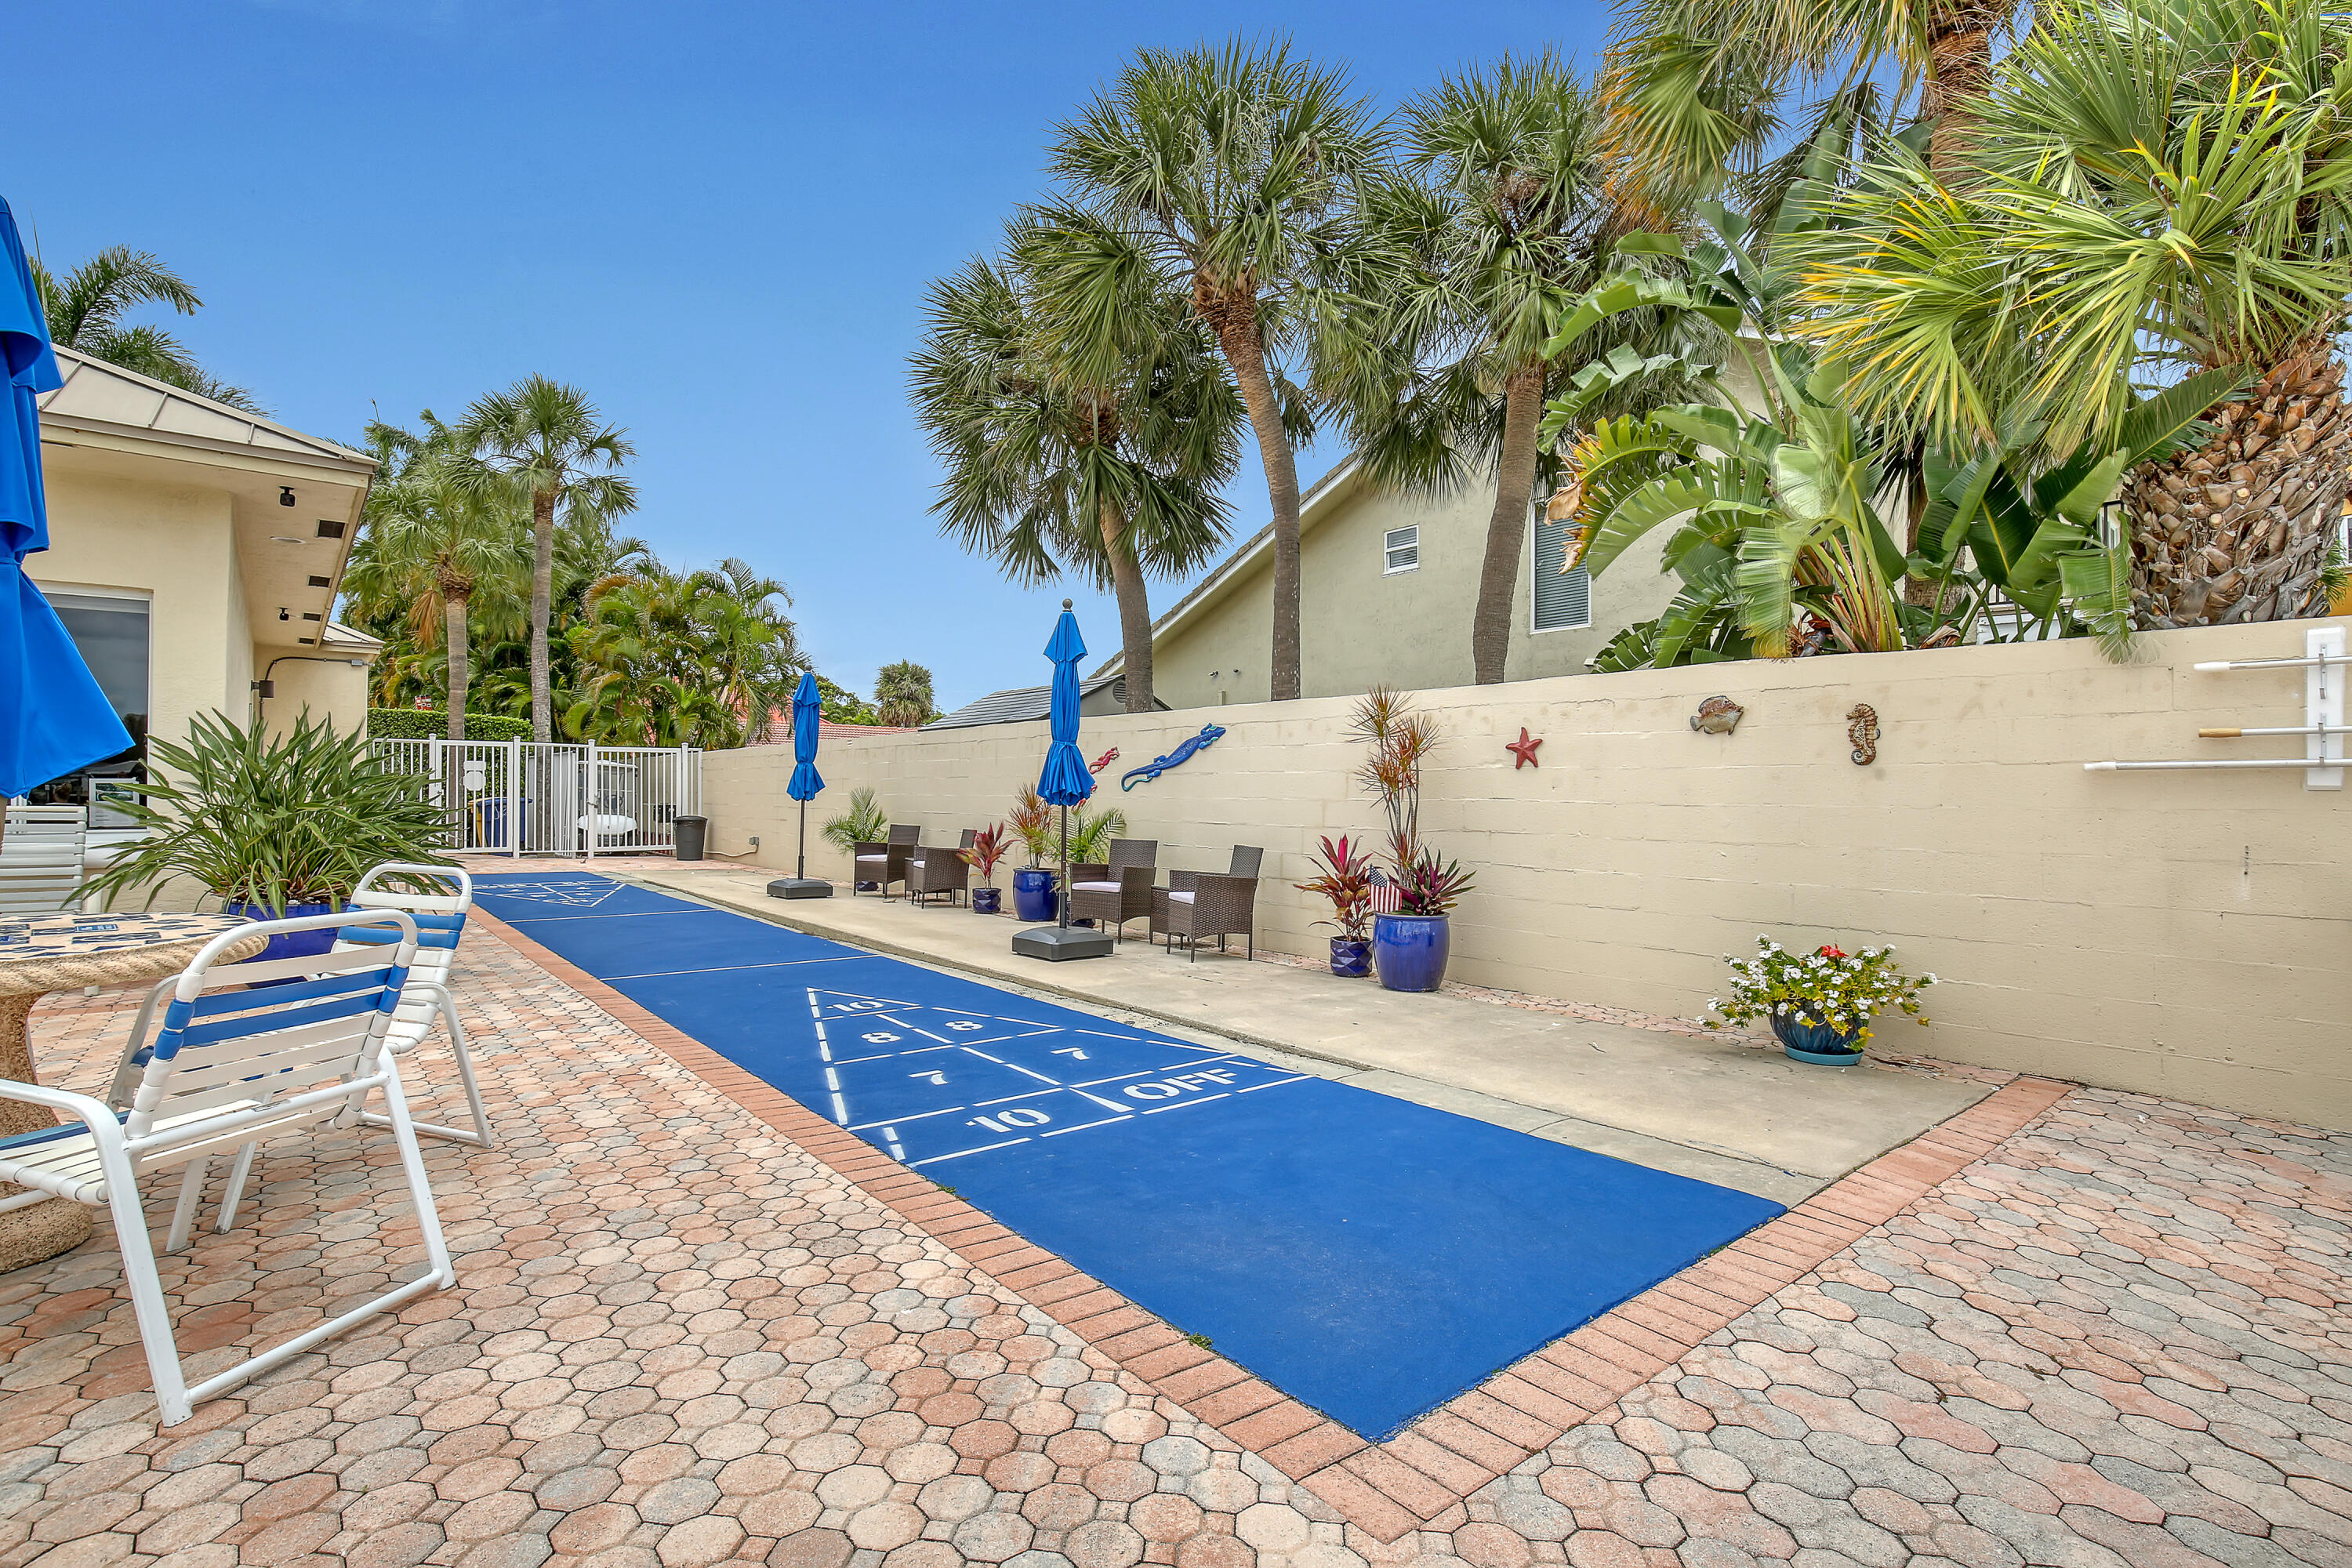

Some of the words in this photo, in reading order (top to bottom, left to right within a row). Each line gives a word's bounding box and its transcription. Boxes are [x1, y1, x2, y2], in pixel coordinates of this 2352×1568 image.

[826, 1001, 884, 1012] 10
[945, 1021, 984, 1031] 8
[860, 1032, 902, 1044] 8
[1050, 1047, 1091, 1061] 7
[908, 1069, 949, 1086] 7
[1123, 1068, 1238, 1100] OFF
[965, 1108, 1051, 1133] 10
